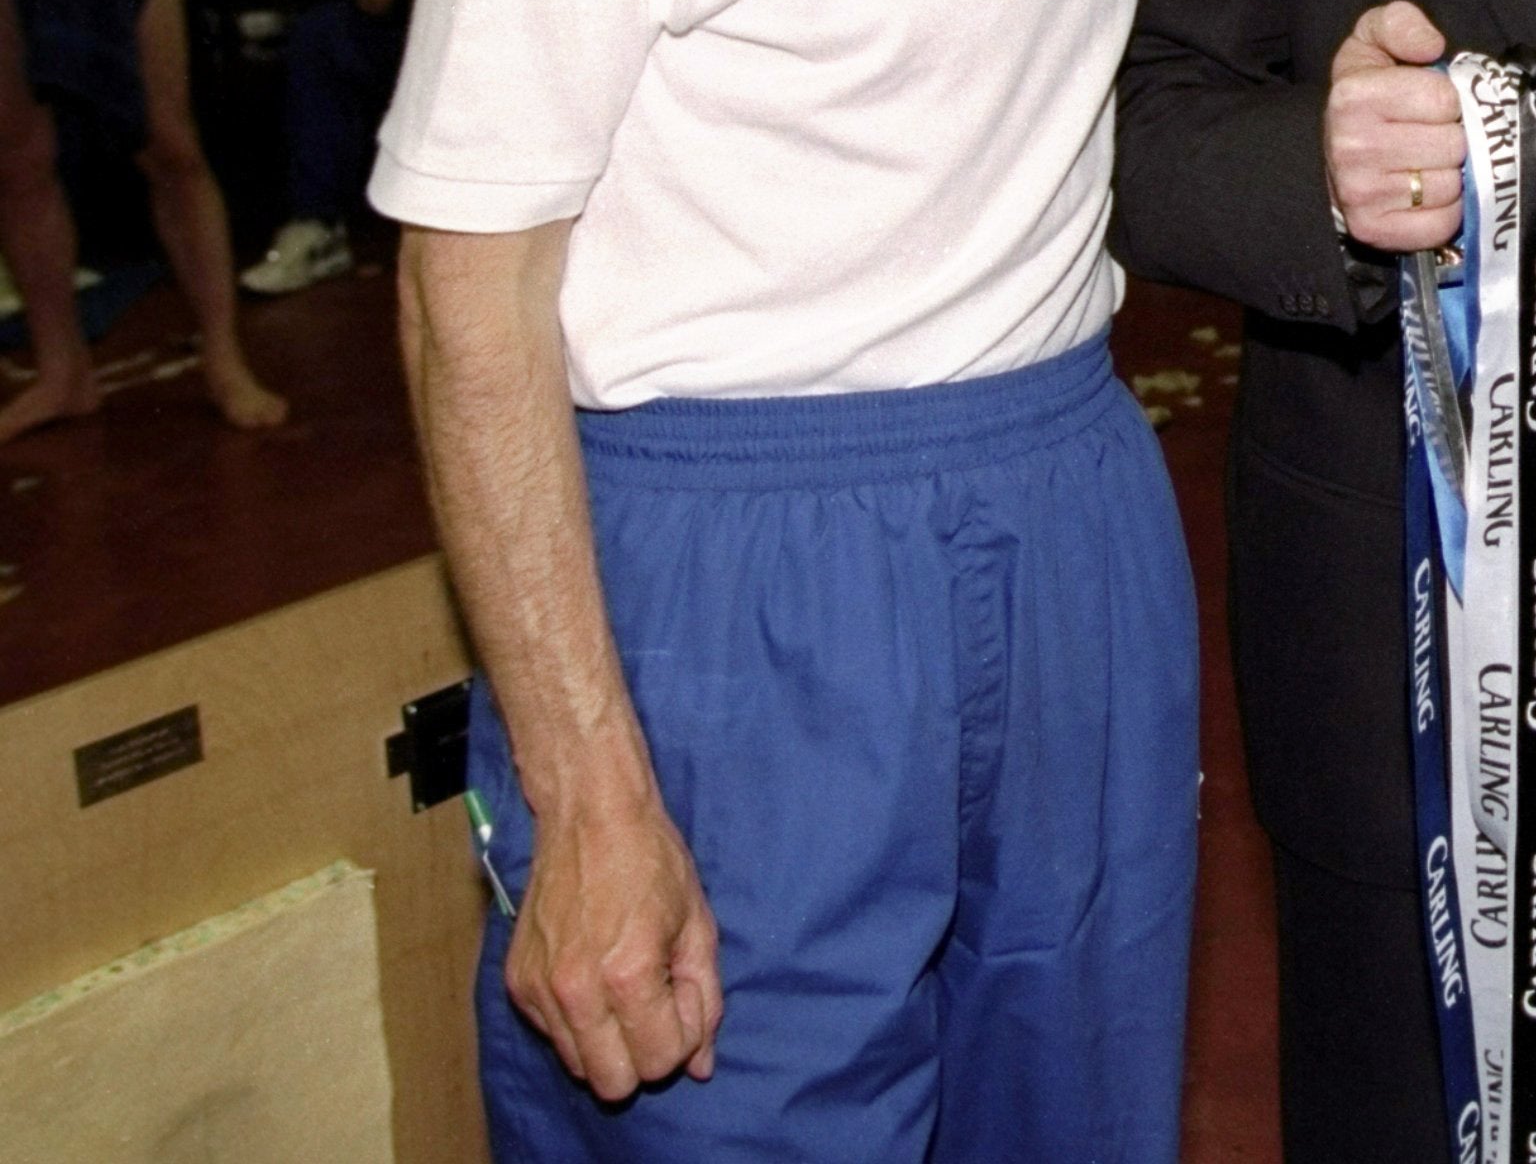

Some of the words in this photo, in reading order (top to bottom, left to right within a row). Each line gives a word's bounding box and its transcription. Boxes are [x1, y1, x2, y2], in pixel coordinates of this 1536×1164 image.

[1471, 73, 1518, 252] CARLING
[1483, 372, 1515, 549] CARLING
[1414, 557, 1435, 735] CARLING
[1477, 662, 1513, 822] CARLING
[1426, 834, 1464, 1010] CARLING
[1469, 832, 1509, 950] CARLI
